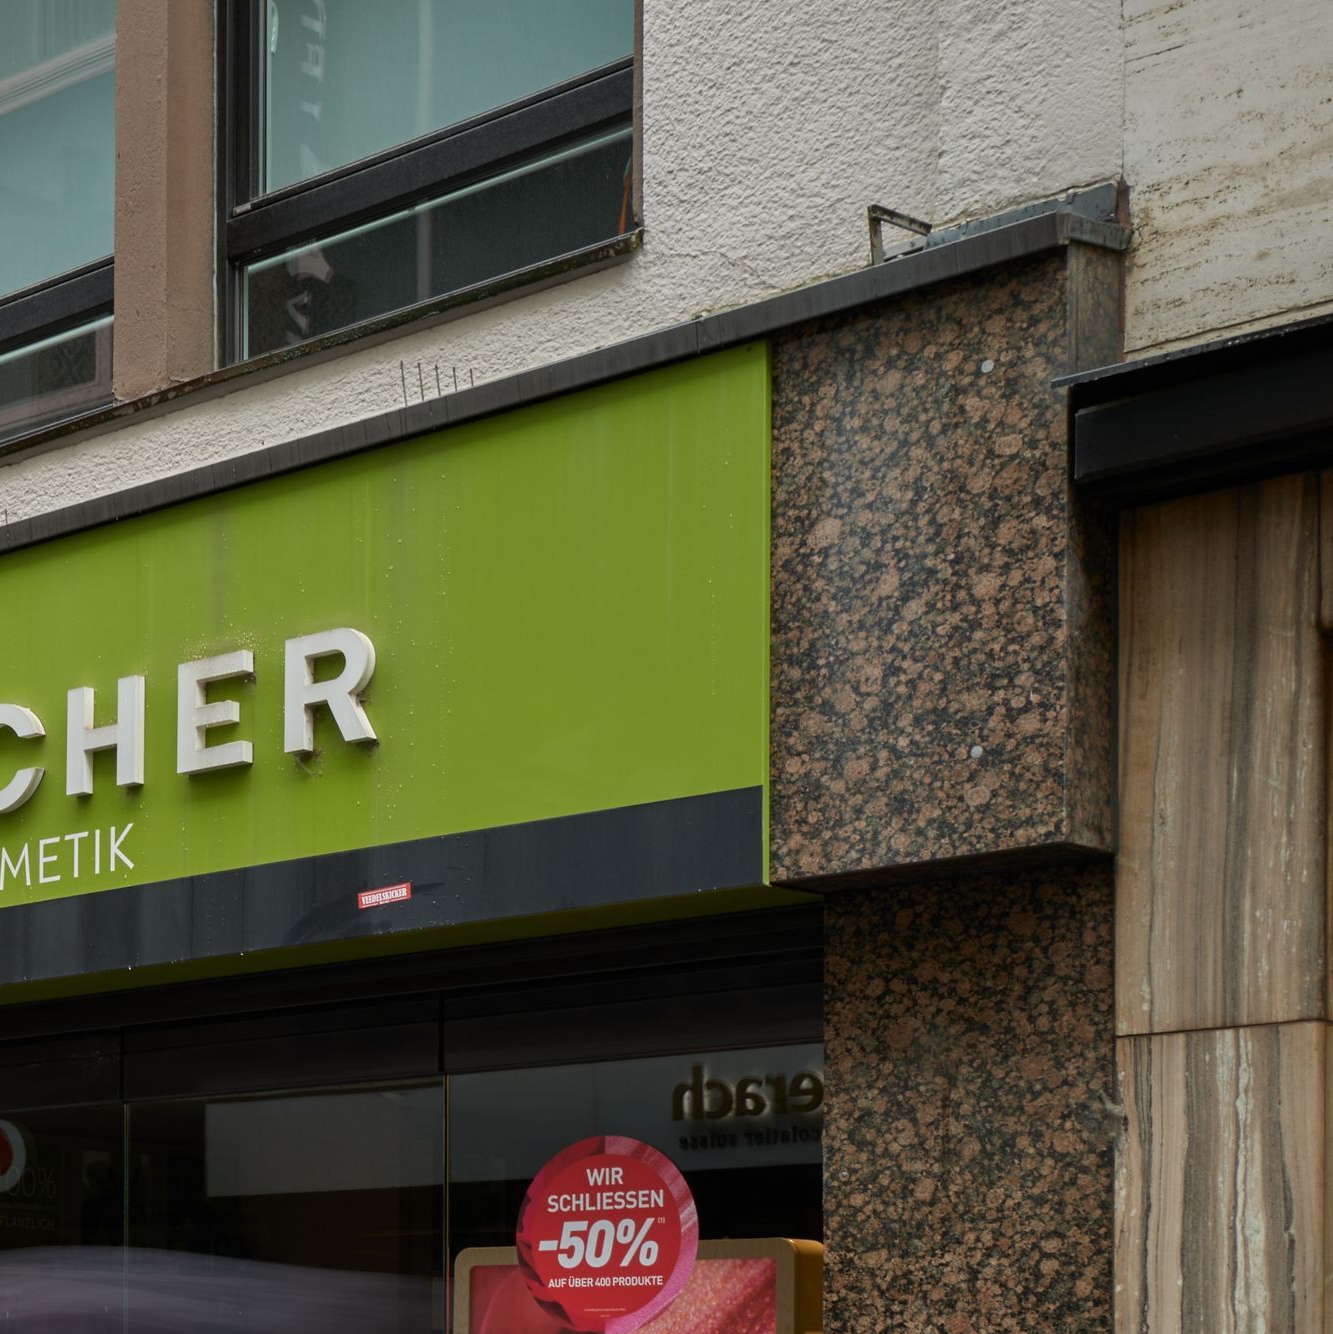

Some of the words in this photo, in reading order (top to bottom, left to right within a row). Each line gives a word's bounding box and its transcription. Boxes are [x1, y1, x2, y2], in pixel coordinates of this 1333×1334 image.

[586, 1167, 623, 1186] WIR
[547, 1189, 664, 1213] SCHLIESSEN
[538, 1217, 659, 1269] -50%
[548, 1278, 567, 1288] AUF
[568, 1277, 594, 1288] ÜBER
[595, 1277, 611, 1287] 400
[612, 1275, 664, 1287] PRODUKTE
